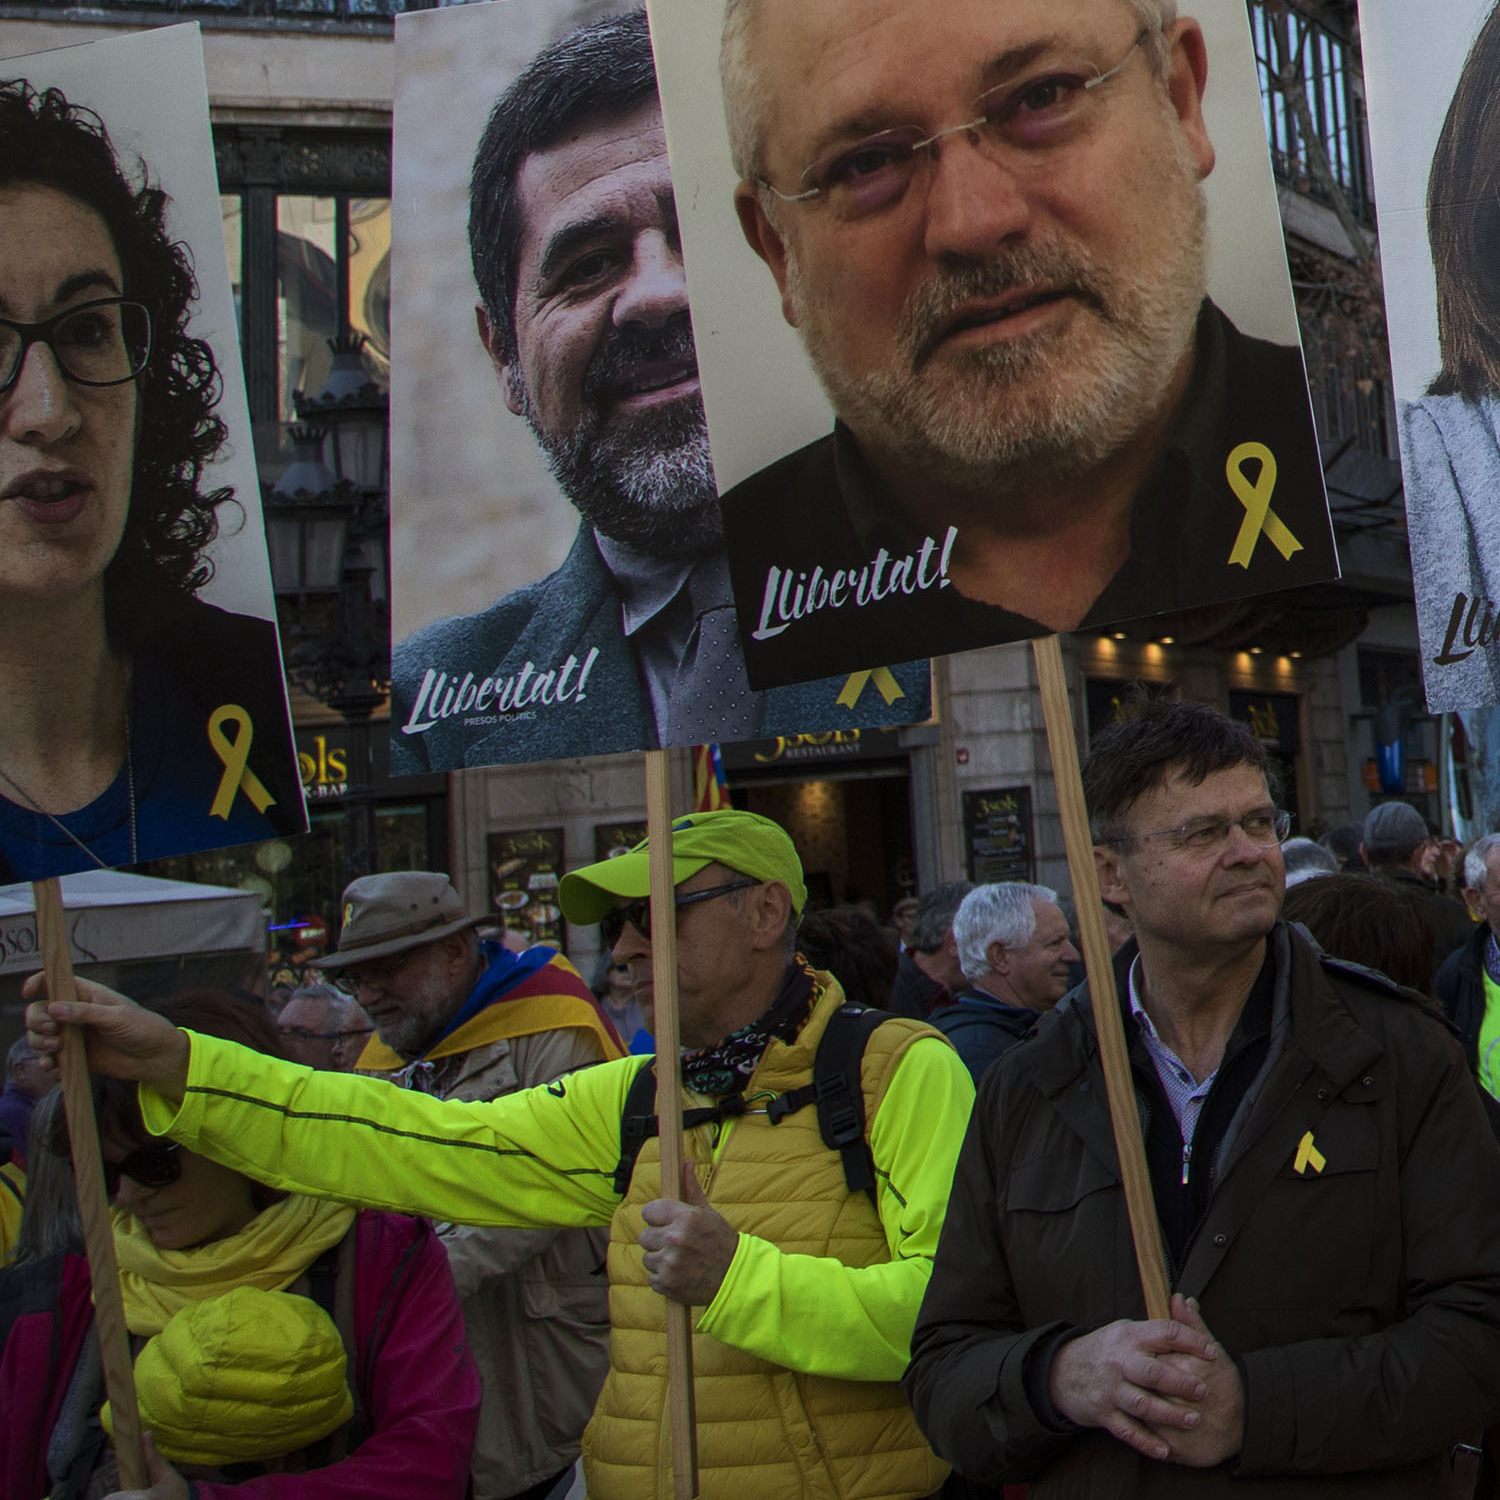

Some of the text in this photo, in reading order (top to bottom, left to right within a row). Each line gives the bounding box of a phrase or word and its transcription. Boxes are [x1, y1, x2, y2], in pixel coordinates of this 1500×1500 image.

[751, 525, 958, 641] Llibertat!
[400, 646, 600, 735] Llibertat!
[464, 714, 498, 726] PRESOS
[786, 743, 862, 759] RESTAURANT
